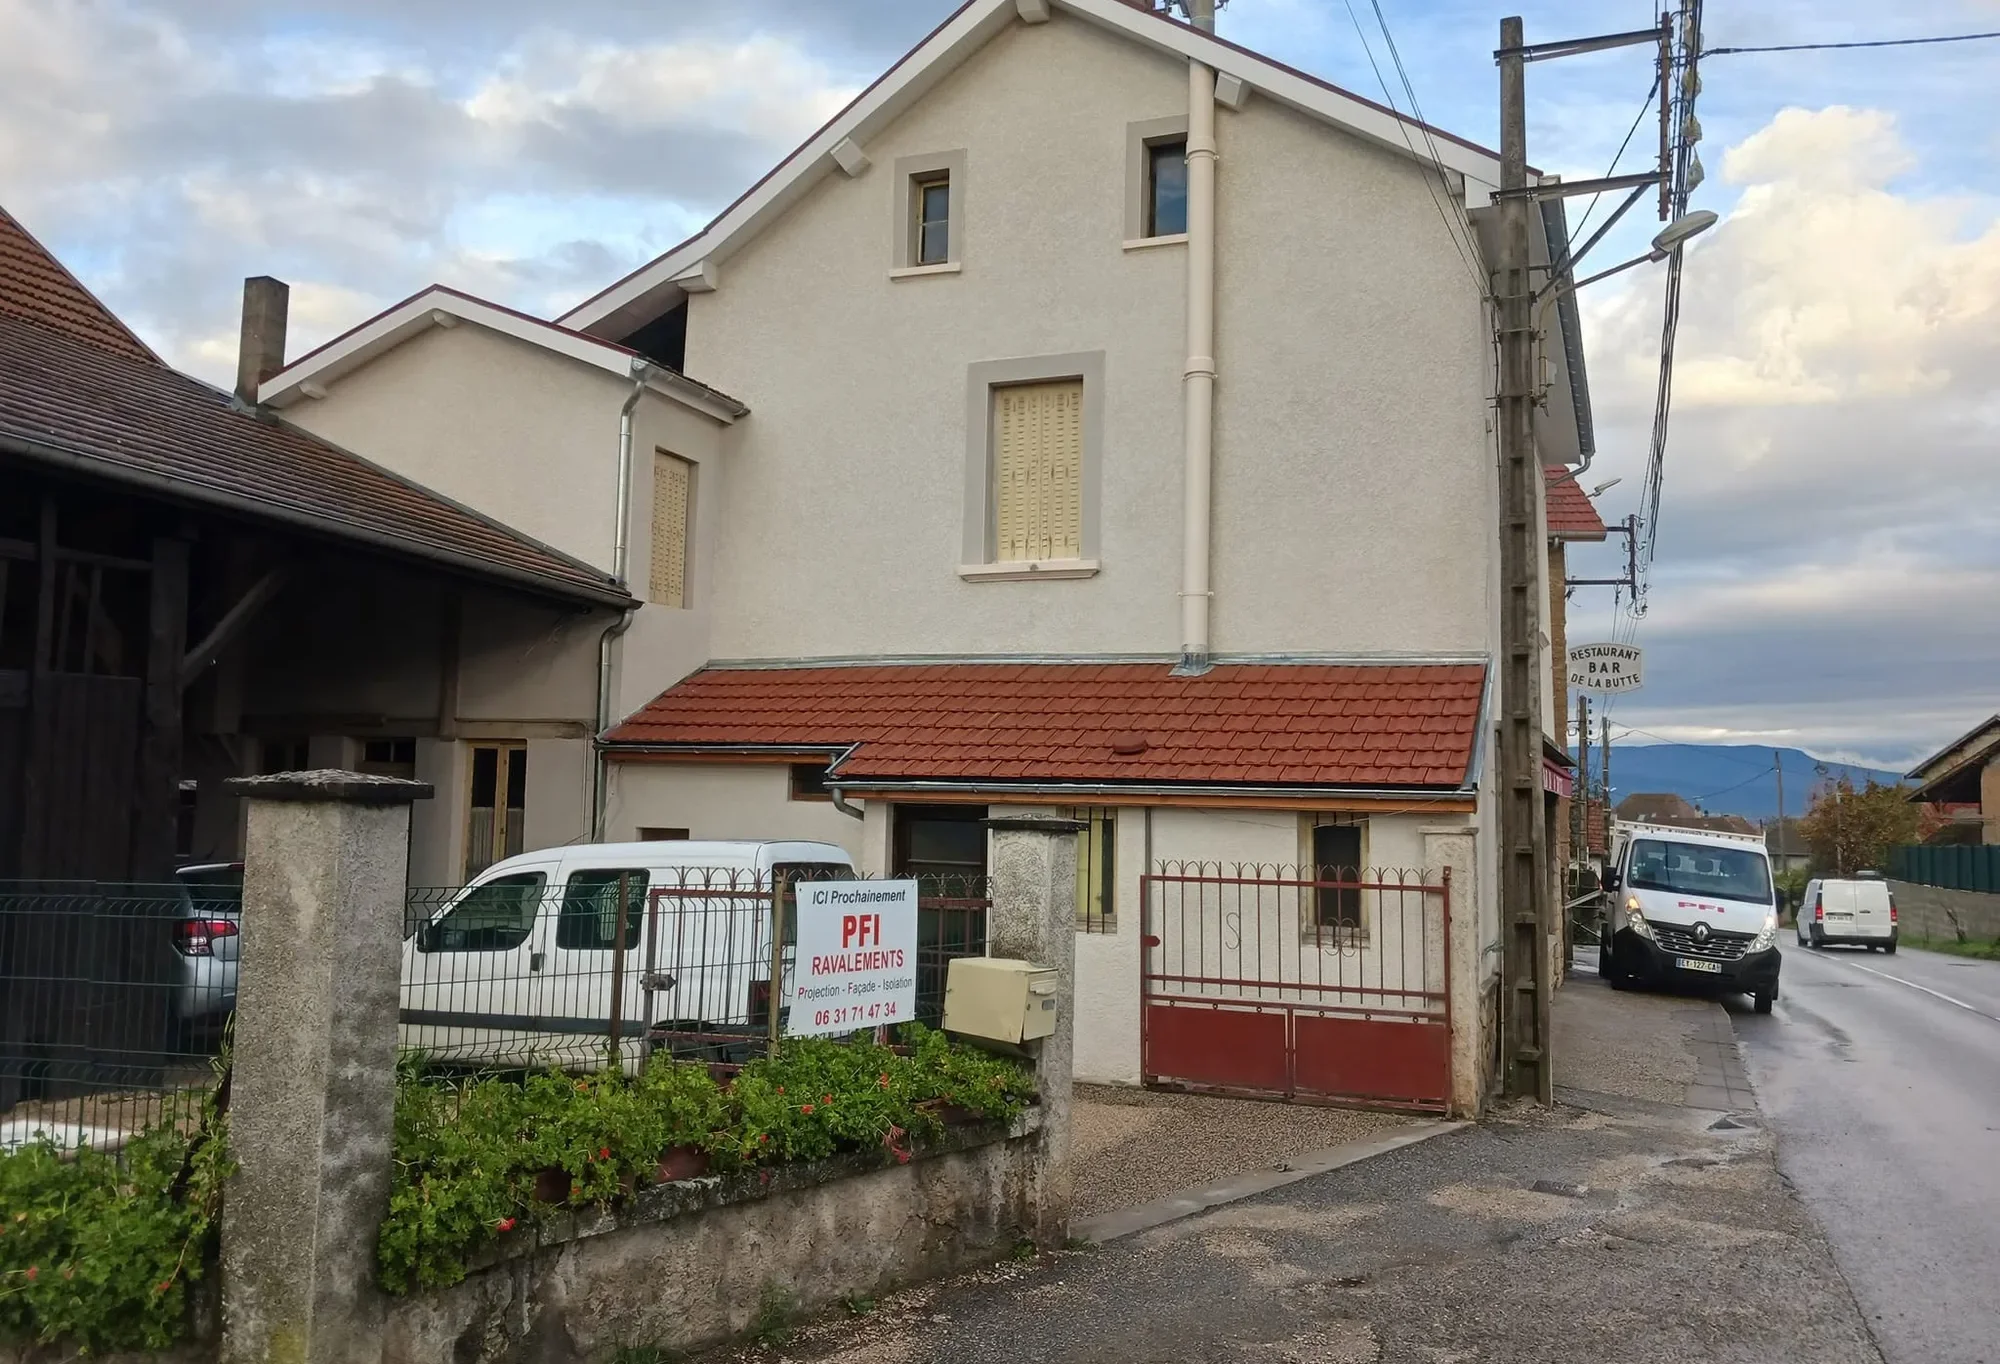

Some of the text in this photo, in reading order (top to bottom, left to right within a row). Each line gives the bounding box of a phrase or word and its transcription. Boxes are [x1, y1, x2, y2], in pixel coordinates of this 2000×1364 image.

[1570, 647, 1640, 661] RESTAURANT
[1589, 662, 1620, 673] BAR
[1571, 674, 1640, 688] DE LA BUTTE
[812, 888, 906, 905] ICI Prochainement
[842, 914, 880, 948] PFI
[812, 949, 904, 976] RAVALEMENTS
[798, 984, 840, 1001] Projection
[848, 981, 876, 997] Façade
[883, 977, 912, 991] Isolation
[815, 1001, 896, 1026] 06 31 71 47 34
